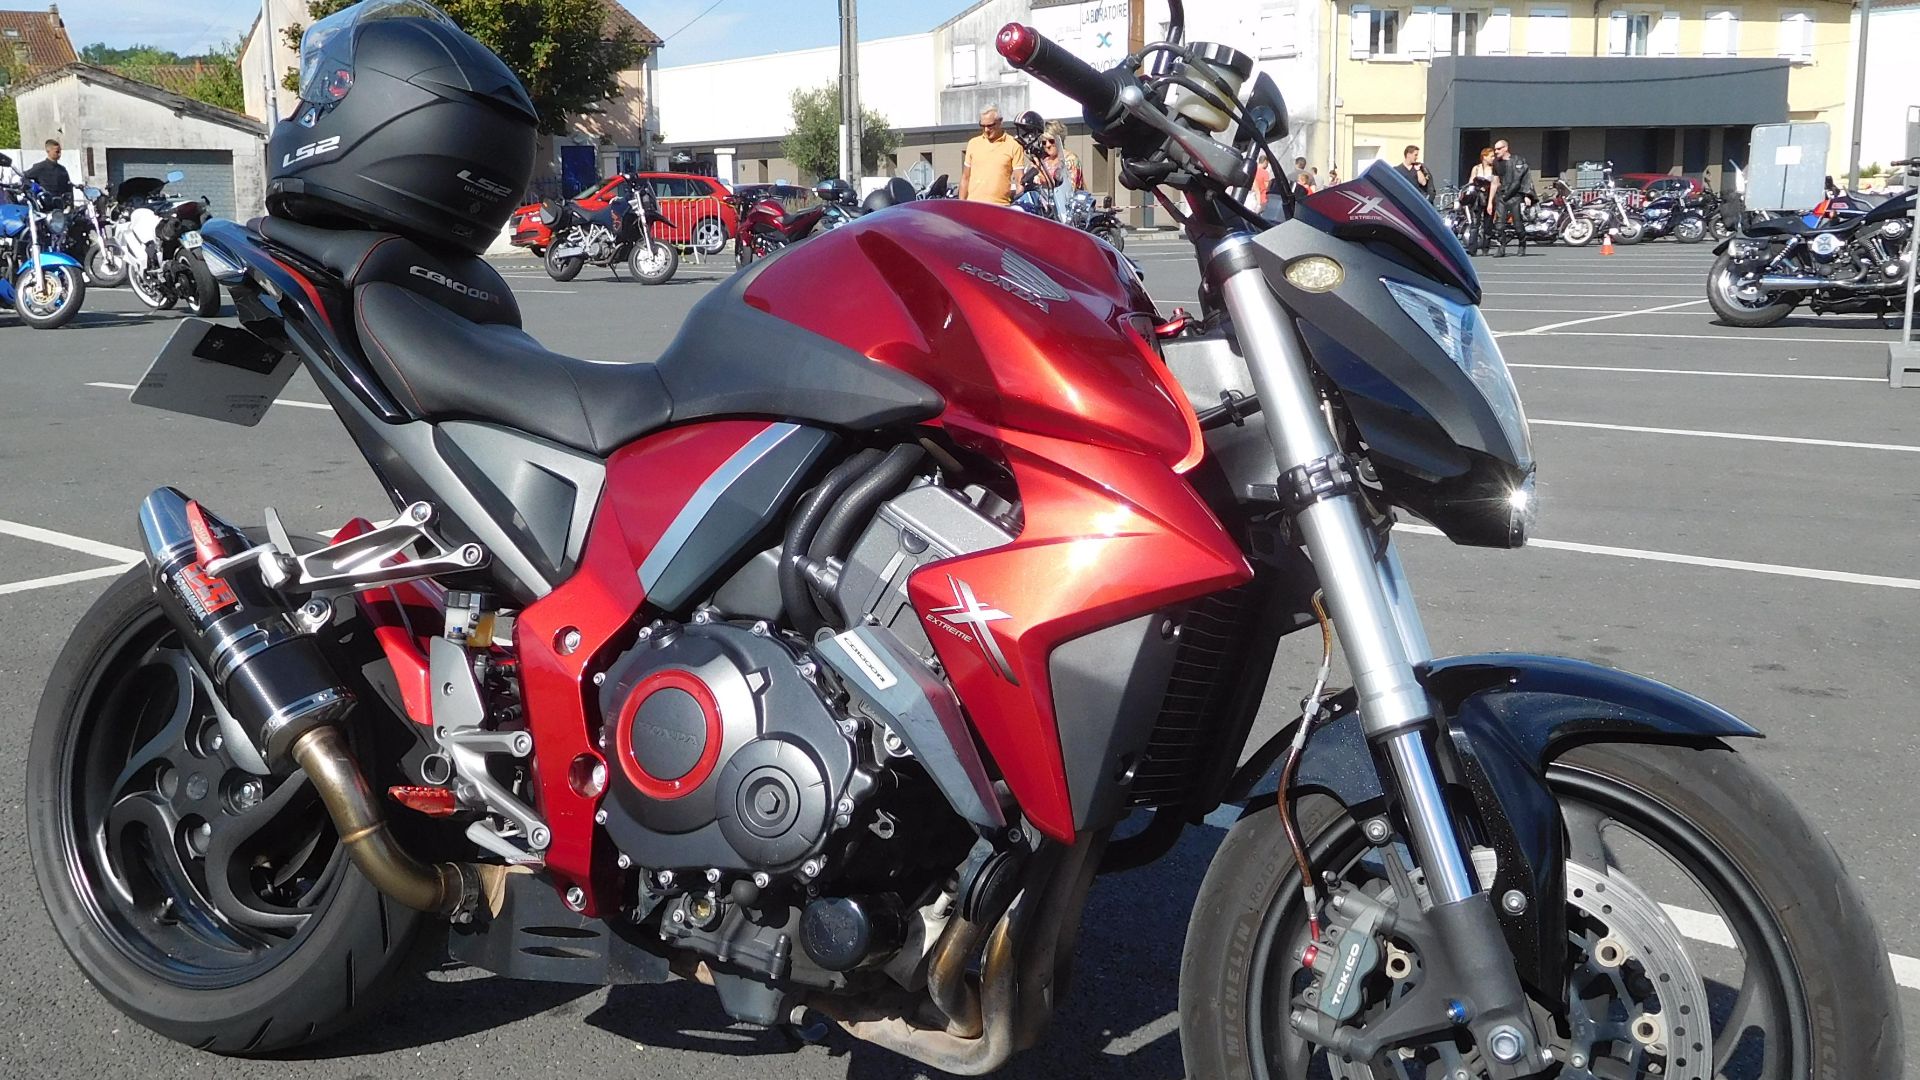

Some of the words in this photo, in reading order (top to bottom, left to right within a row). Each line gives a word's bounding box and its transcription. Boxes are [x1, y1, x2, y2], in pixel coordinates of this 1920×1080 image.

[1081, 3, 1128, 25] LABORATOIRE
[282, 135, 341, 168] LS2
[456, 169, 513, 198] LS2
[409, 265, 500, 304] CB1000R
[957, 262, 1050, 315] HONDA
[925, 613, 973, 643] EXTREME
[1222, 922, 1251, 1058] MICHELIN
[1330, 942, 1360, 1006] TOKICO
